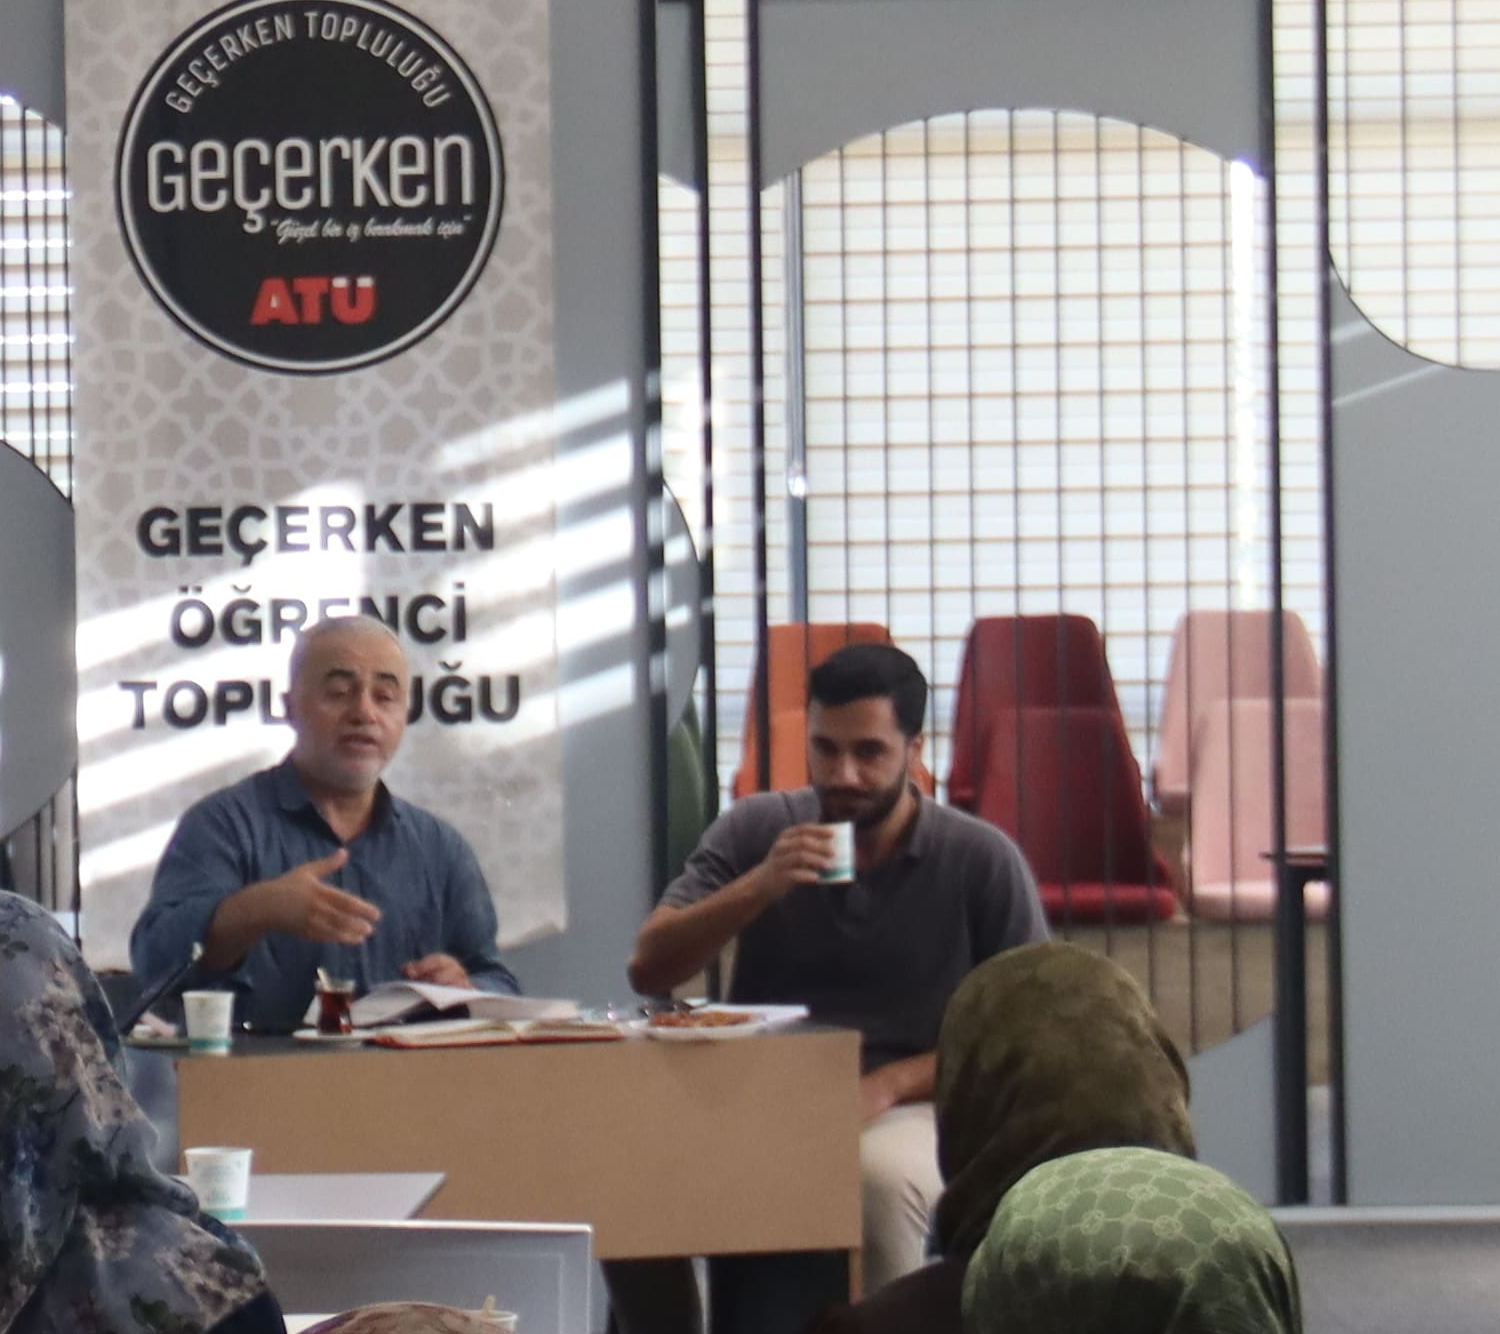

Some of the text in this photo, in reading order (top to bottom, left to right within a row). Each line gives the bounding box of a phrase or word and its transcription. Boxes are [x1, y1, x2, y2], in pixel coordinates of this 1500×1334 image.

[165, 10, 452, 114] GEÇERKEN TOPLULUĞU
[250, 275, 377, 326] ATÜ
[137, 503, 495, 566] GEÇERKEN
[118, 661, 521, 729] TOPLĞU
